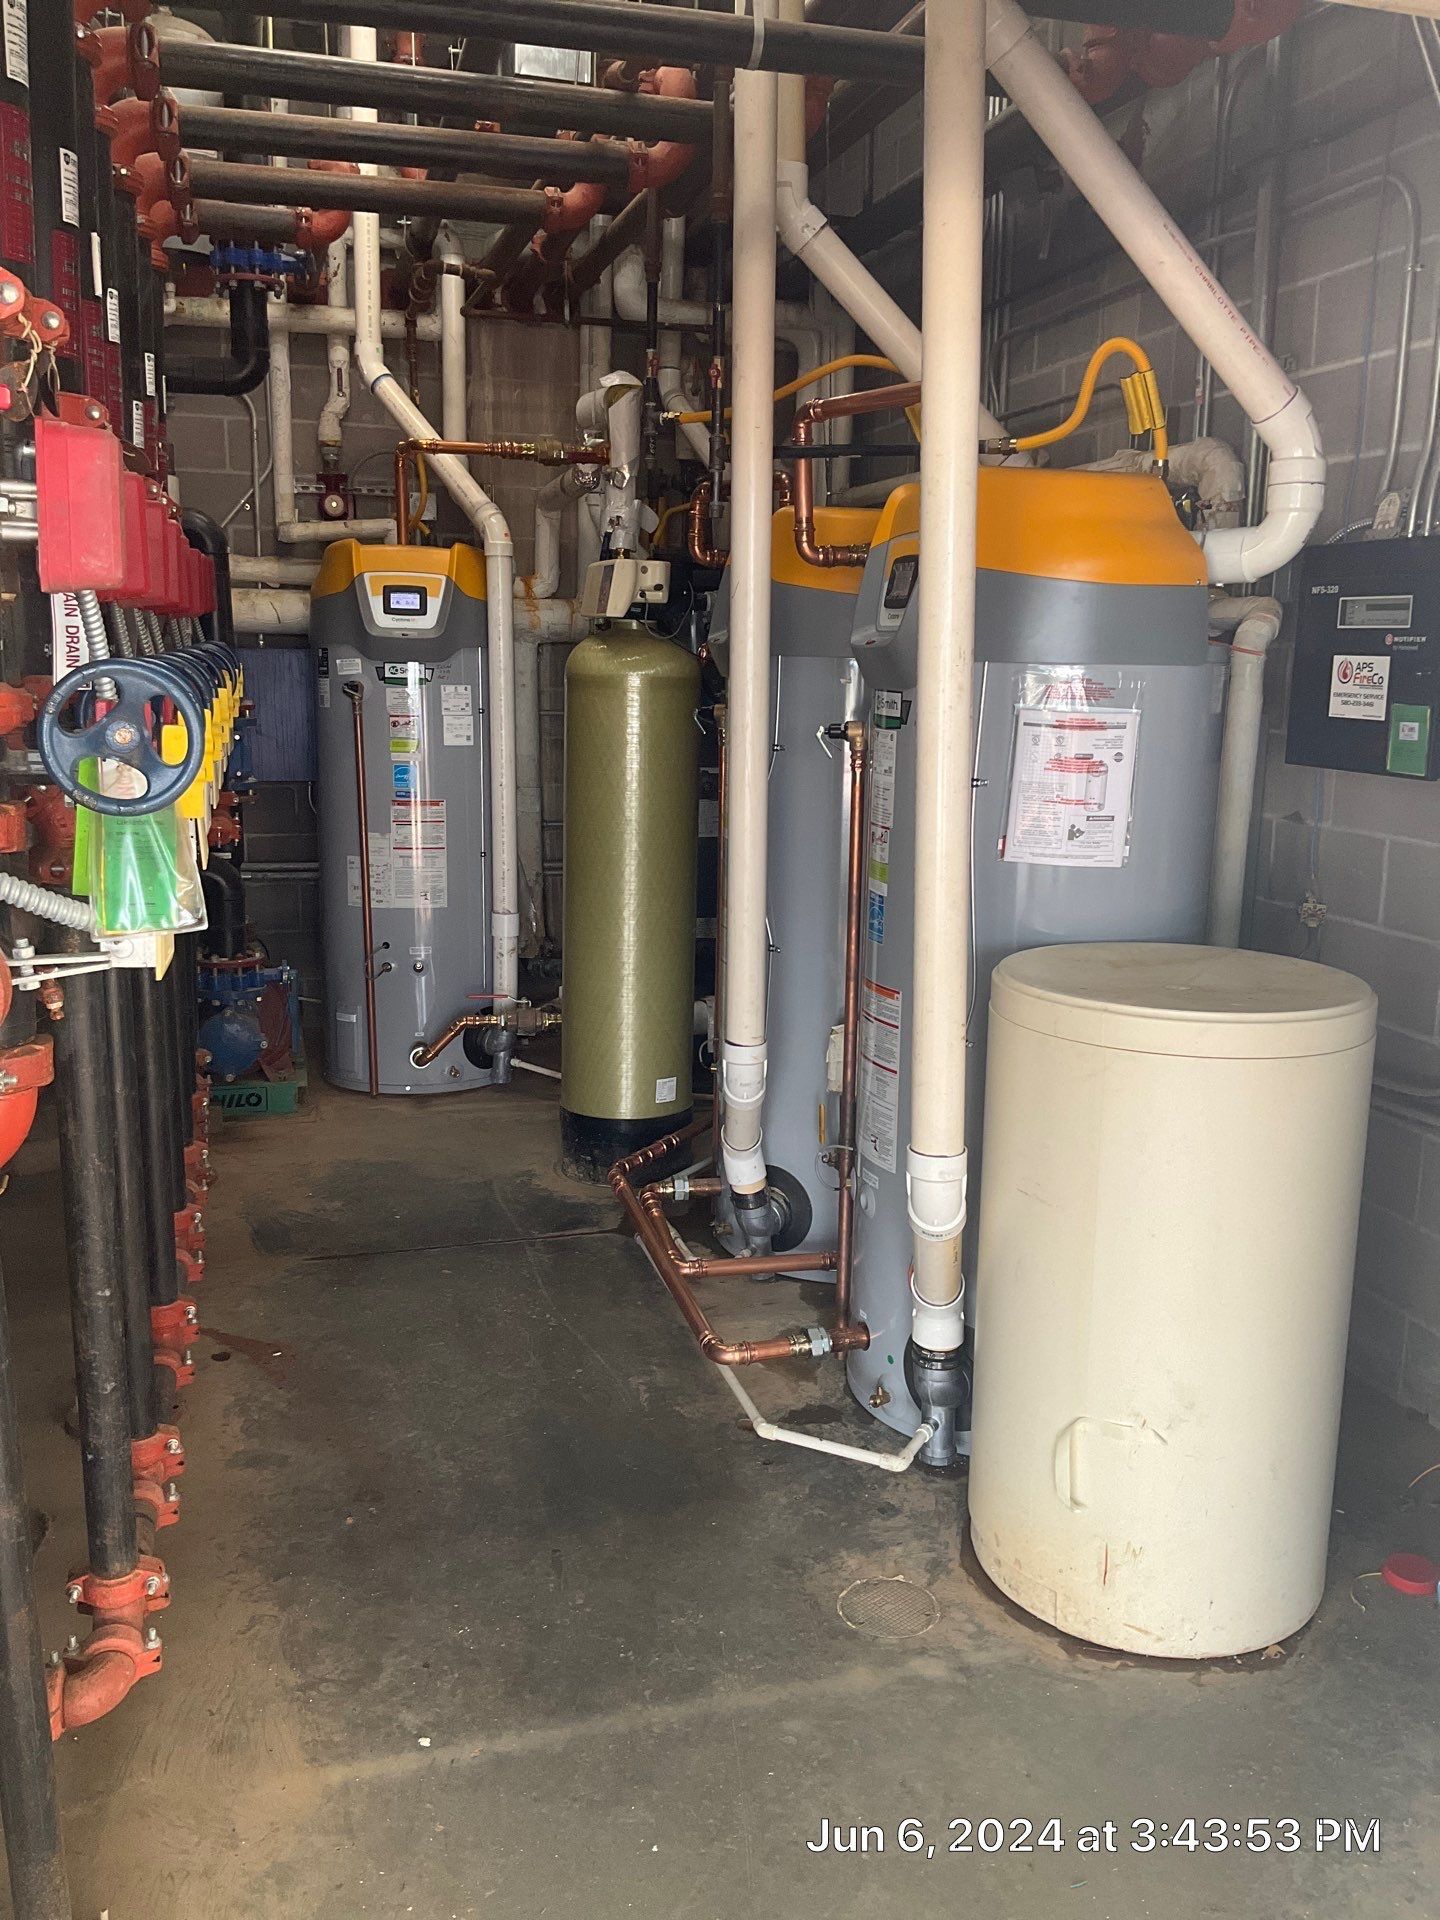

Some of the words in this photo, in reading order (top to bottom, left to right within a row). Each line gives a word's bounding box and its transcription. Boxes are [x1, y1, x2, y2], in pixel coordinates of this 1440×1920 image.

[63, 592, 79, 618] AIN
[65, 625, 81, 669] DRAIN
[1354, 662, 1375, 673] APS
[1352, 673, 1385, 685] FireCo
[1363, 693, 1385, 701] SERVICE
[214, 1092, 263, 1109] ILO
